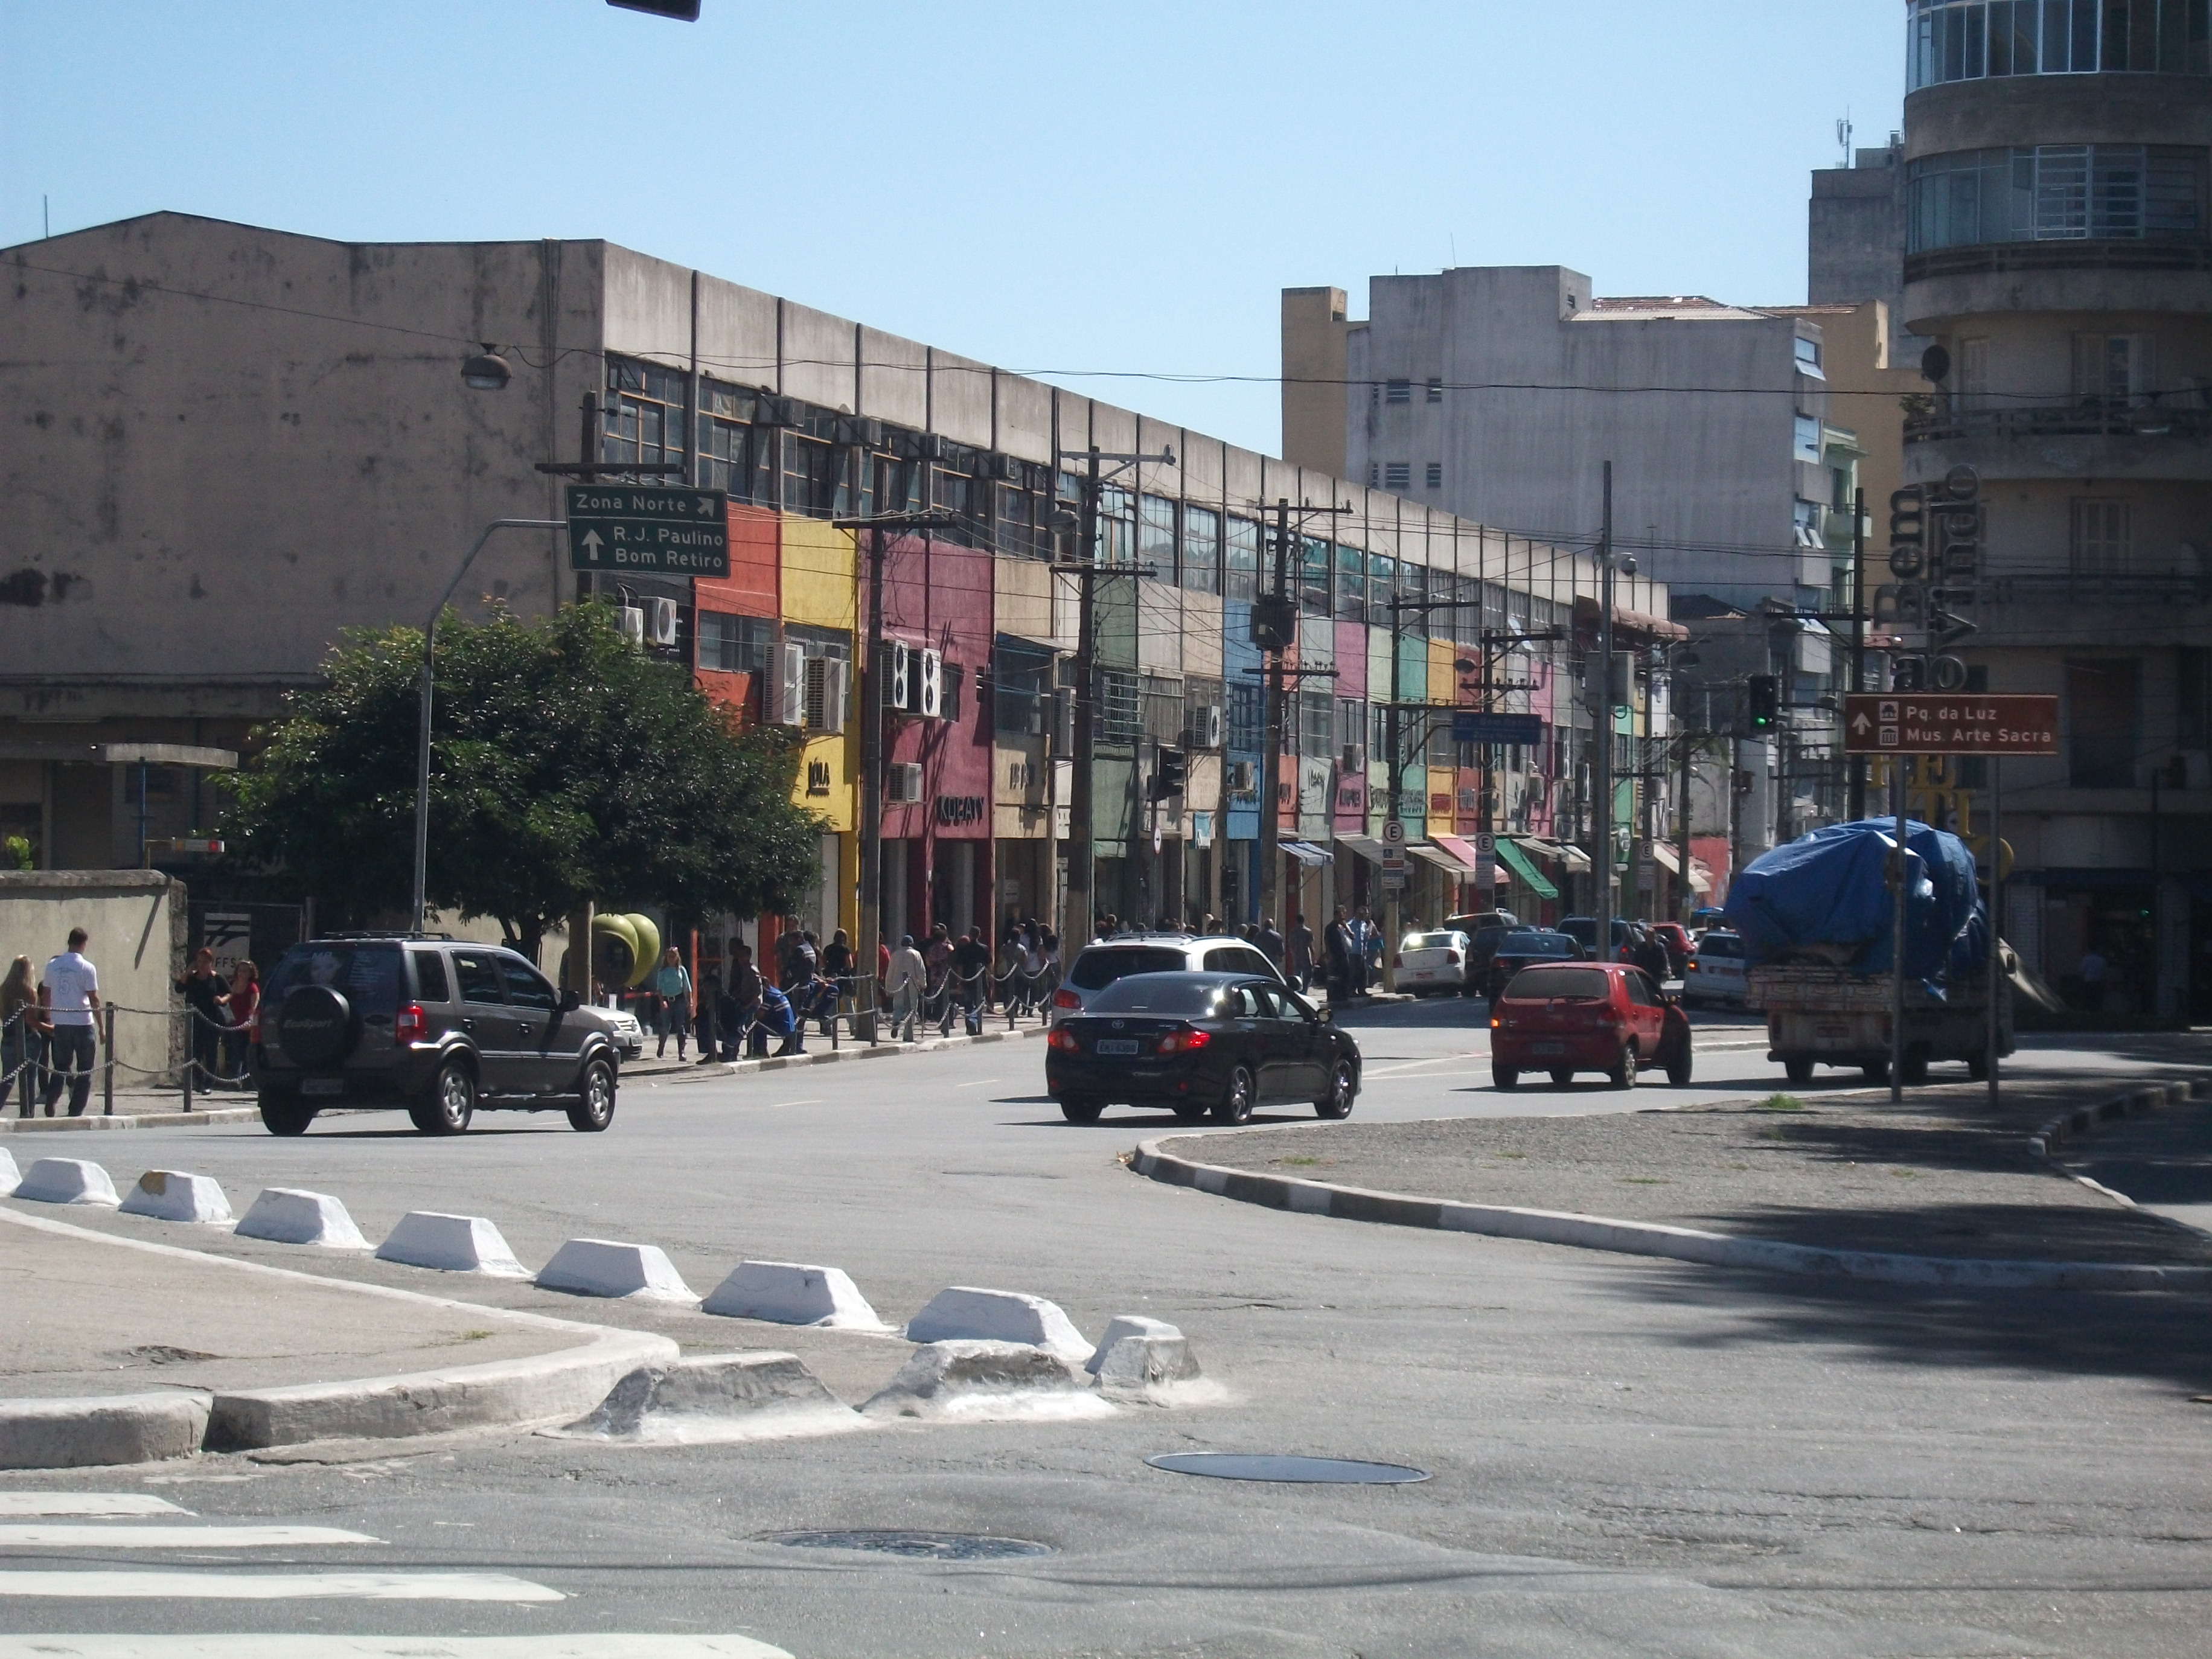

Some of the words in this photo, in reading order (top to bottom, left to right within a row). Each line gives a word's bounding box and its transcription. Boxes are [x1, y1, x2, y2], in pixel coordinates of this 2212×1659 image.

[576, 493, 622, 510] Zona
[633, 495, 686, 512] Norte
[613, 526, 630, 541] R.
[635, 528, 650, 542] J.
[658, 528, 723, 546] Paulino
[615, 548, 656, 563] Bom
[666, 551, 722, 568] Retiro
[1873, 485, 1926, 630] Bem
[1907, 706, 1931, 722] Pq.
[1939, 706, 1958, 720] da
[1965, 707, 1997, 720] Luz
[1907, 729, 1945, 742] Mus.
[1952, 729, 1991, 742] Arte
[1998, 729, 2051, 743] Sacra
[1390, 826, 1397, 838] E
[1482, 837, 1488, 848] E
